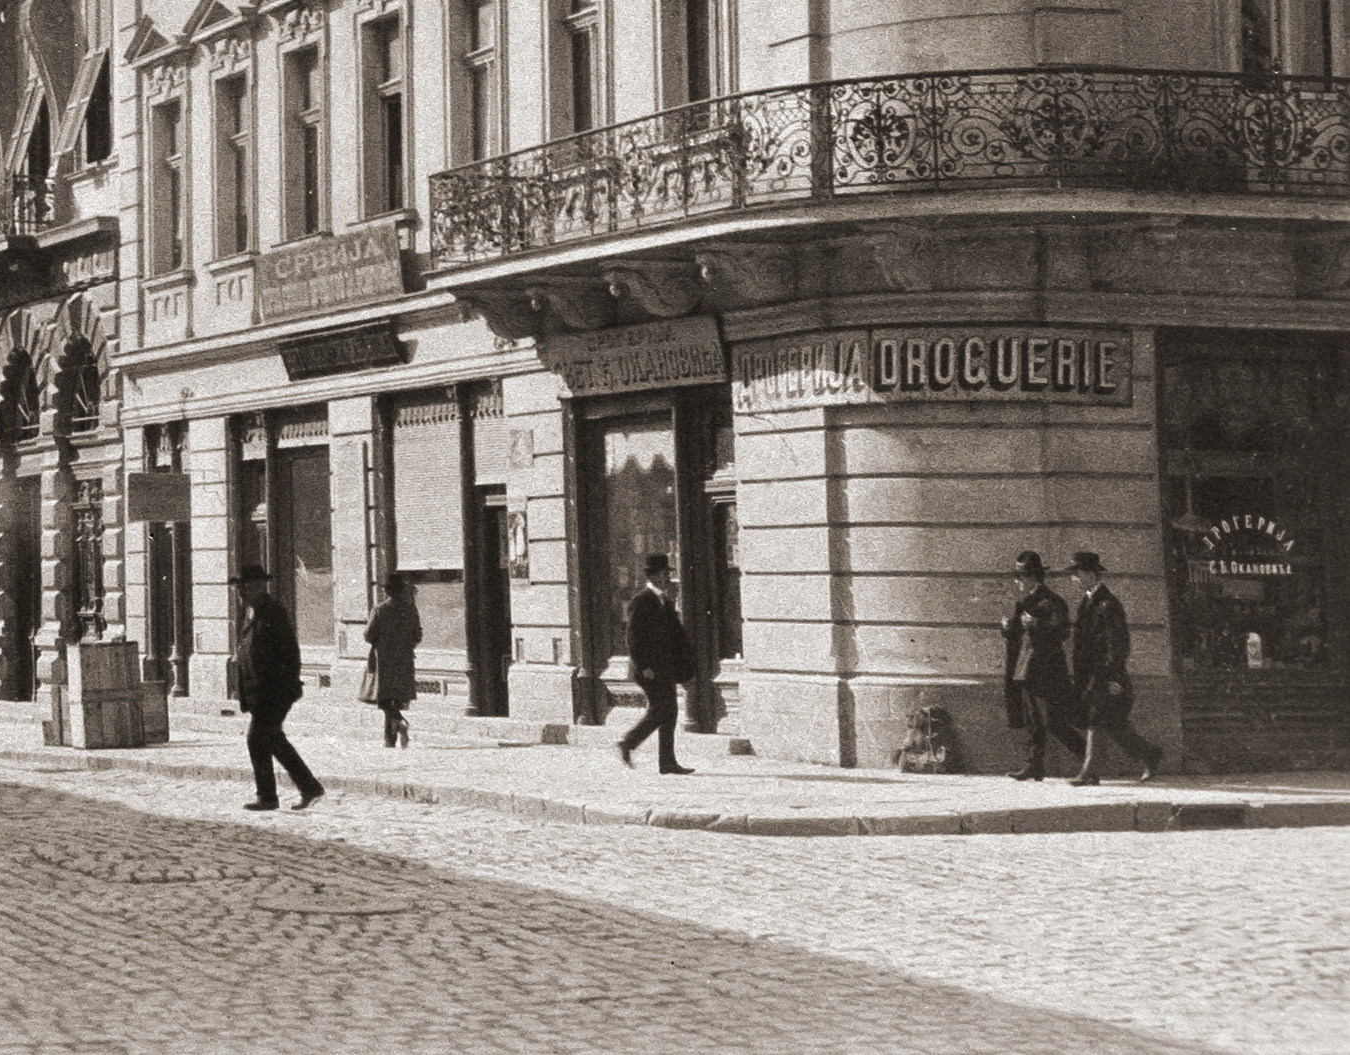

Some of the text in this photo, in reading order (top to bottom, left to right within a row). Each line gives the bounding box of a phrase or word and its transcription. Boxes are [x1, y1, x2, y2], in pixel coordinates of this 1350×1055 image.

[275, 237, 383, 279] СРБИЈА
[737, 341, 864, 409] ДРОГЕРИЈА
[876, 337, 1118, 390] DROGUERIE
[1202, 514, 1295, 551] ДРОГЕРИЈА
